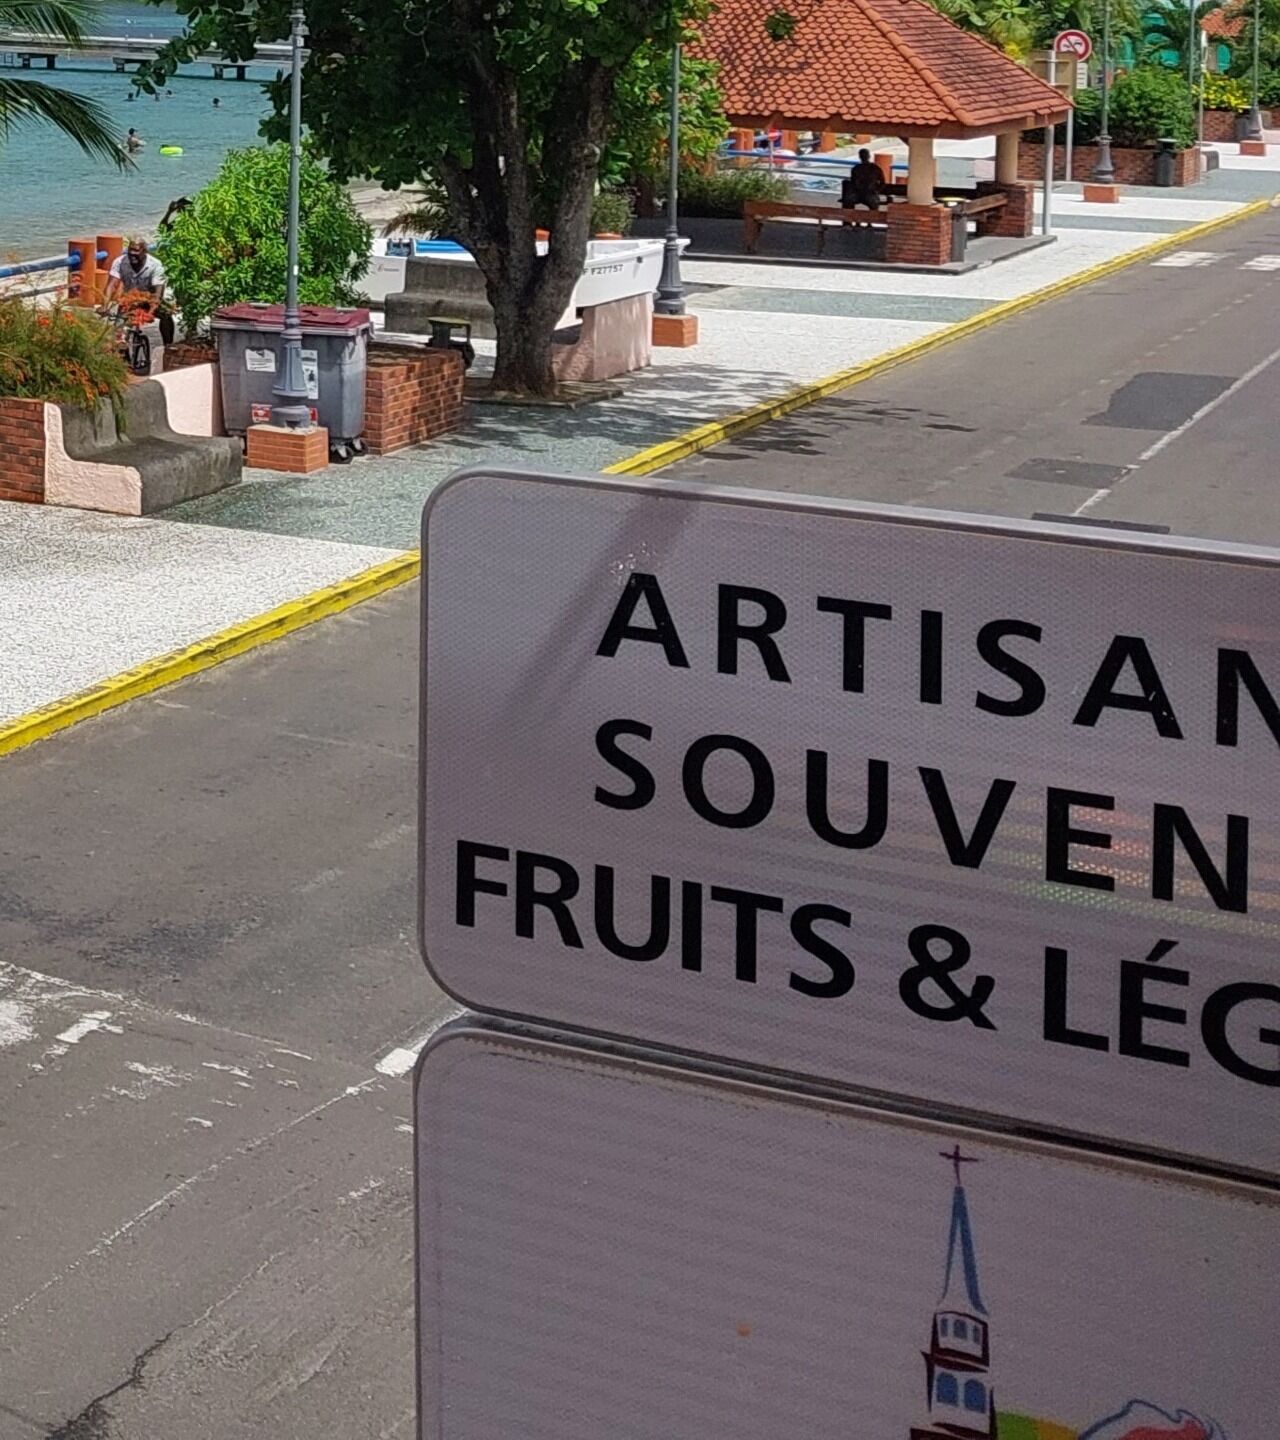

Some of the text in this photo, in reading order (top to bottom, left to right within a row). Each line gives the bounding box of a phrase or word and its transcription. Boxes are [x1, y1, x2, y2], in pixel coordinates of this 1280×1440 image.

[595, 572, 1280, 750] ARTISAN
[594, 718, 1249, 914] SOUVEN
[455, 839, 1280, 1087] FRUITS & LÉG
